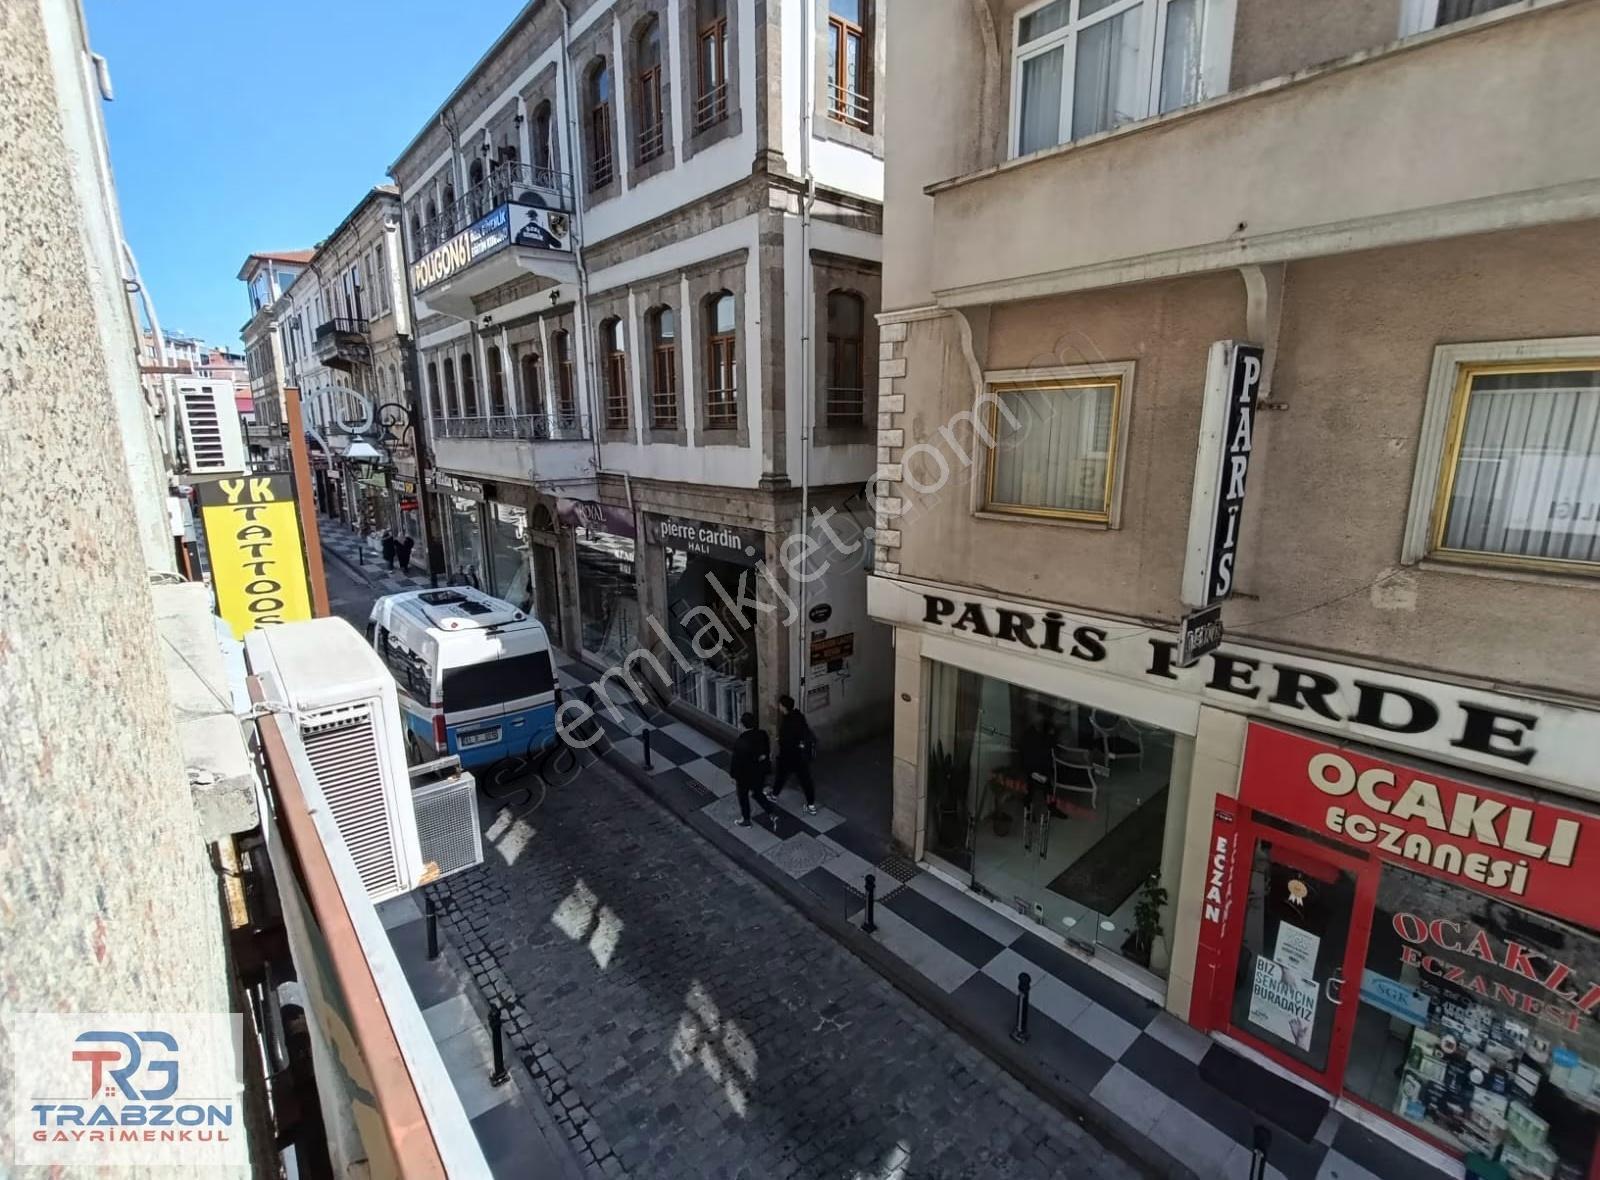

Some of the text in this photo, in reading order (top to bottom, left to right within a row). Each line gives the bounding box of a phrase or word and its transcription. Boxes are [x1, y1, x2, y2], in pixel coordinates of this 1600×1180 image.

[219, 477, 275, 504] YK
[660, 520, 742, 551] pierre cardin
[688, 542, 710, 555] HALI
[921, 594, 1108, 663] PARİS
[1307, 752, 1580, 868] OCAKLI
[1325, 806, 1530, 896] ECZANESİ
[1392, 911, 1600, 1015] OCAKLI
[1254, 984, 1313, 1022] BURADAYIZ
